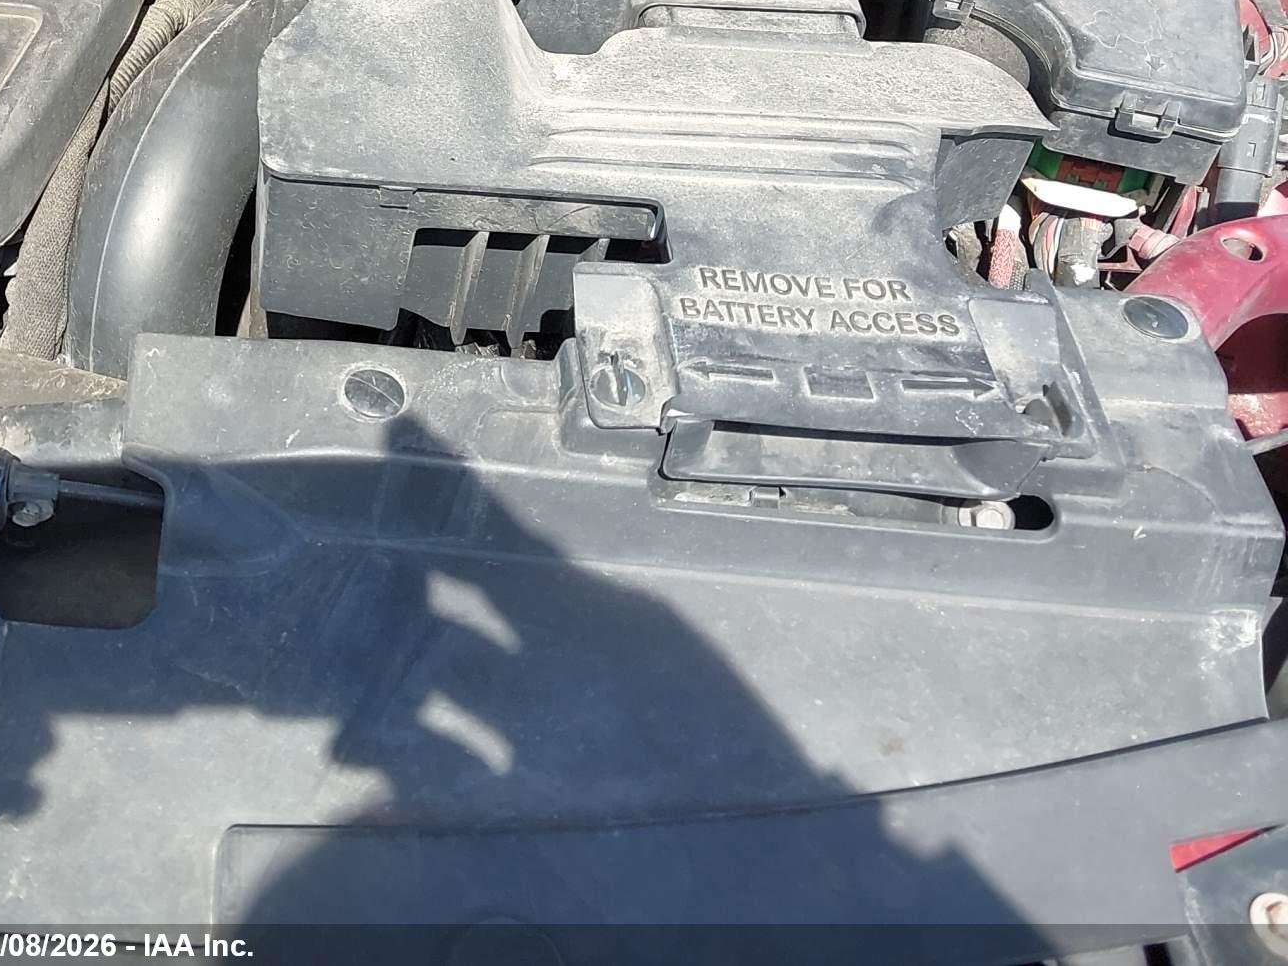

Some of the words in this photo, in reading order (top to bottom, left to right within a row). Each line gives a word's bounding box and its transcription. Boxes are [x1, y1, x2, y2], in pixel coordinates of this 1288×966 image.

[698, 266, 836, 300] REMOVE
[843, 278, 913, 302] FOR
[679, 296, 815, 331] BATTERY
[829, 309, 962, 335] ACCESS
